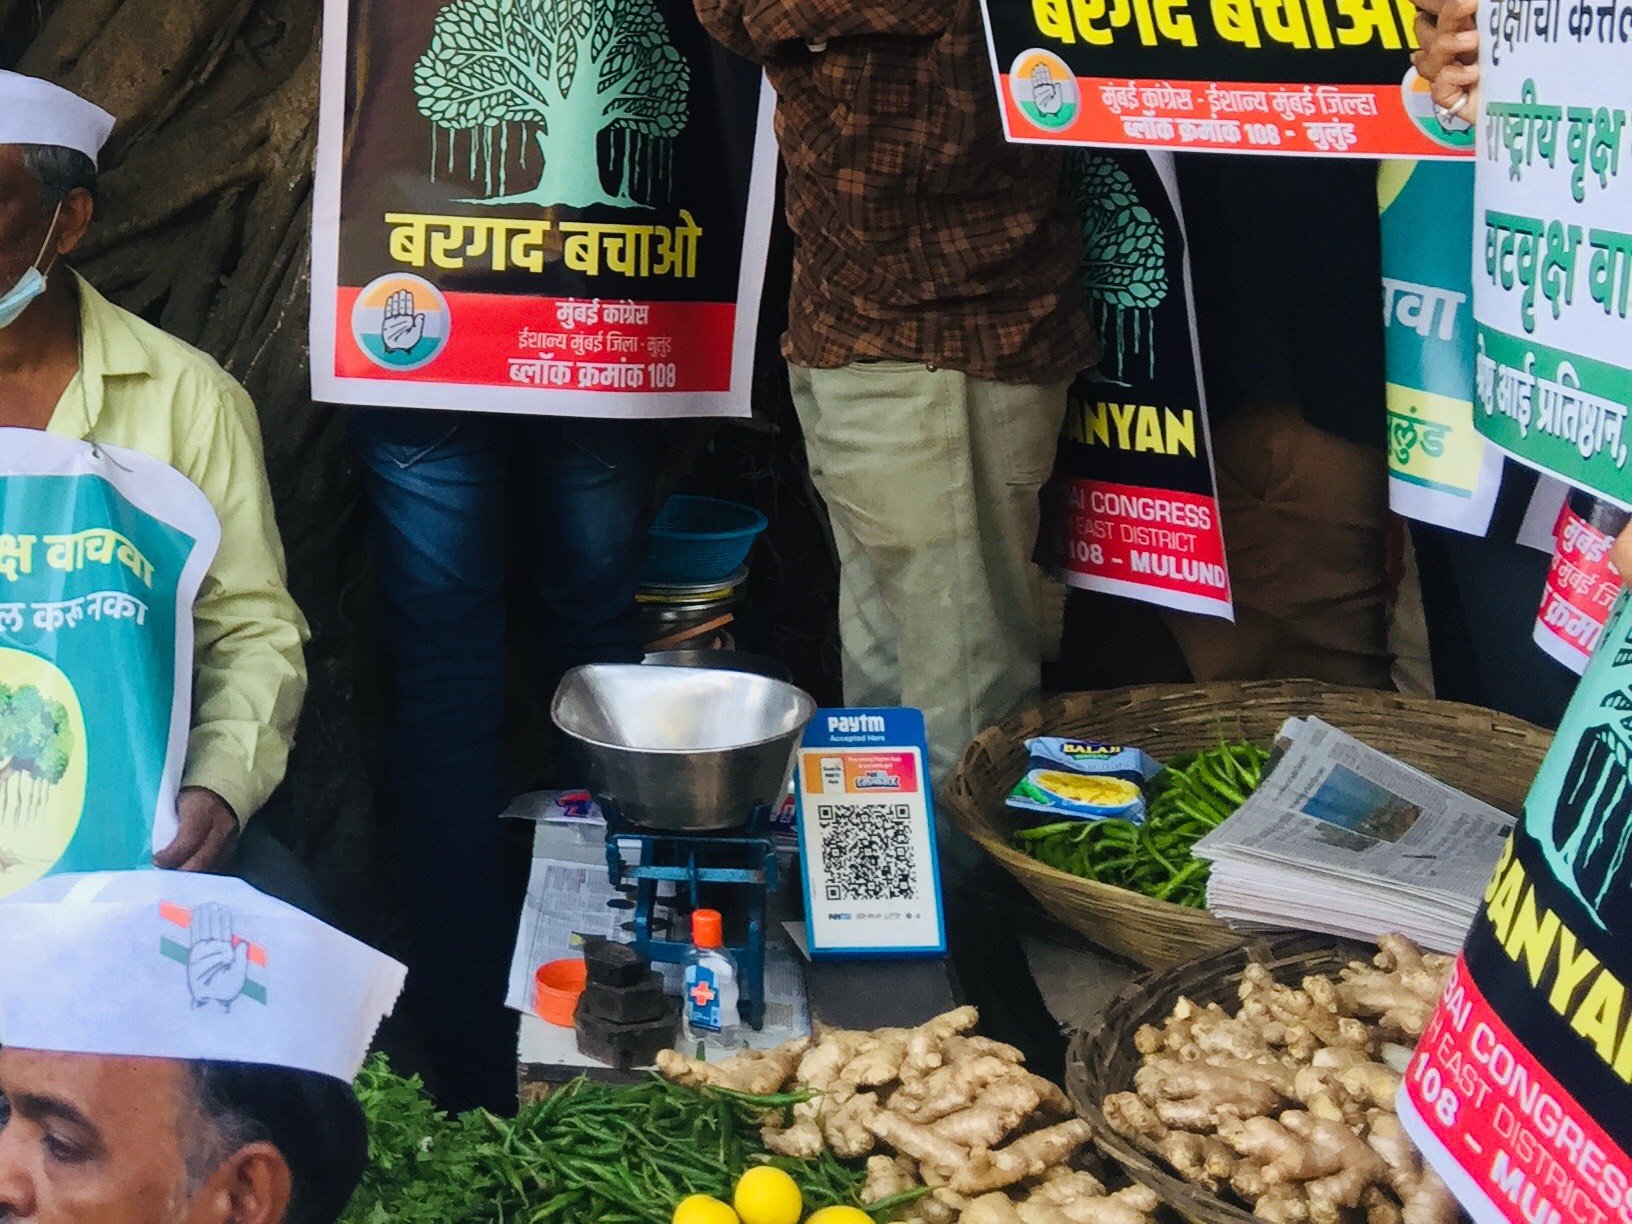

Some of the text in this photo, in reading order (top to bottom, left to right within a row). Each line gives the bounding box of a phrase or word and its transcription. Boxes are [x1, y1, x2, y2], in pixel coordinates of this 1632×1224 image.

[1099, 80, 1378, 121] मुंबई कांग्रेस ईशान्य मुंबई जिल्हा
[1120, 110, 1357, 151] ब्लॉक क्रमांक 108 मुलुंड
[1486, 78, 1625, 203] राष्ट्रीय वृक्ष
[385, 209, 703, 279] बरगद बचाओ
[1485, 209, 1582, 334] वटवृक्ष
[555, 297, 650, 329] मुंबई कांग्रेस
[519, 327, 567, 349] ईशान्य
[570, 330, 604, 356] मुंबई
[606, 332, 639, 353] जिला
[508, 352, 676, 388] ब्लॉक क्रमांक 108
[1498, 351, 1536, 440] आई
[1537, 360, 1628, 469] प्रतिष्ठान,
[1387, 406, 1453, 466] लुंड
[1091, 491, 1211, 531] CONGRESS
[44, 527, 154, 588] वाचवा
[1120, 523, 1197, 553] DISTRICT
[1130, 549, 1226, 589] MULUND
[31, 597, 87, 631] करू
[86, 591, 149, 625] नका
[1063, 743, 1121, 753] BALAJI
[1414, 1053, 1459, 1127] 108
[1437, 1033, 1493, 1108] EAST
[1493, 1102, 1609, 1224] DISTRICT
